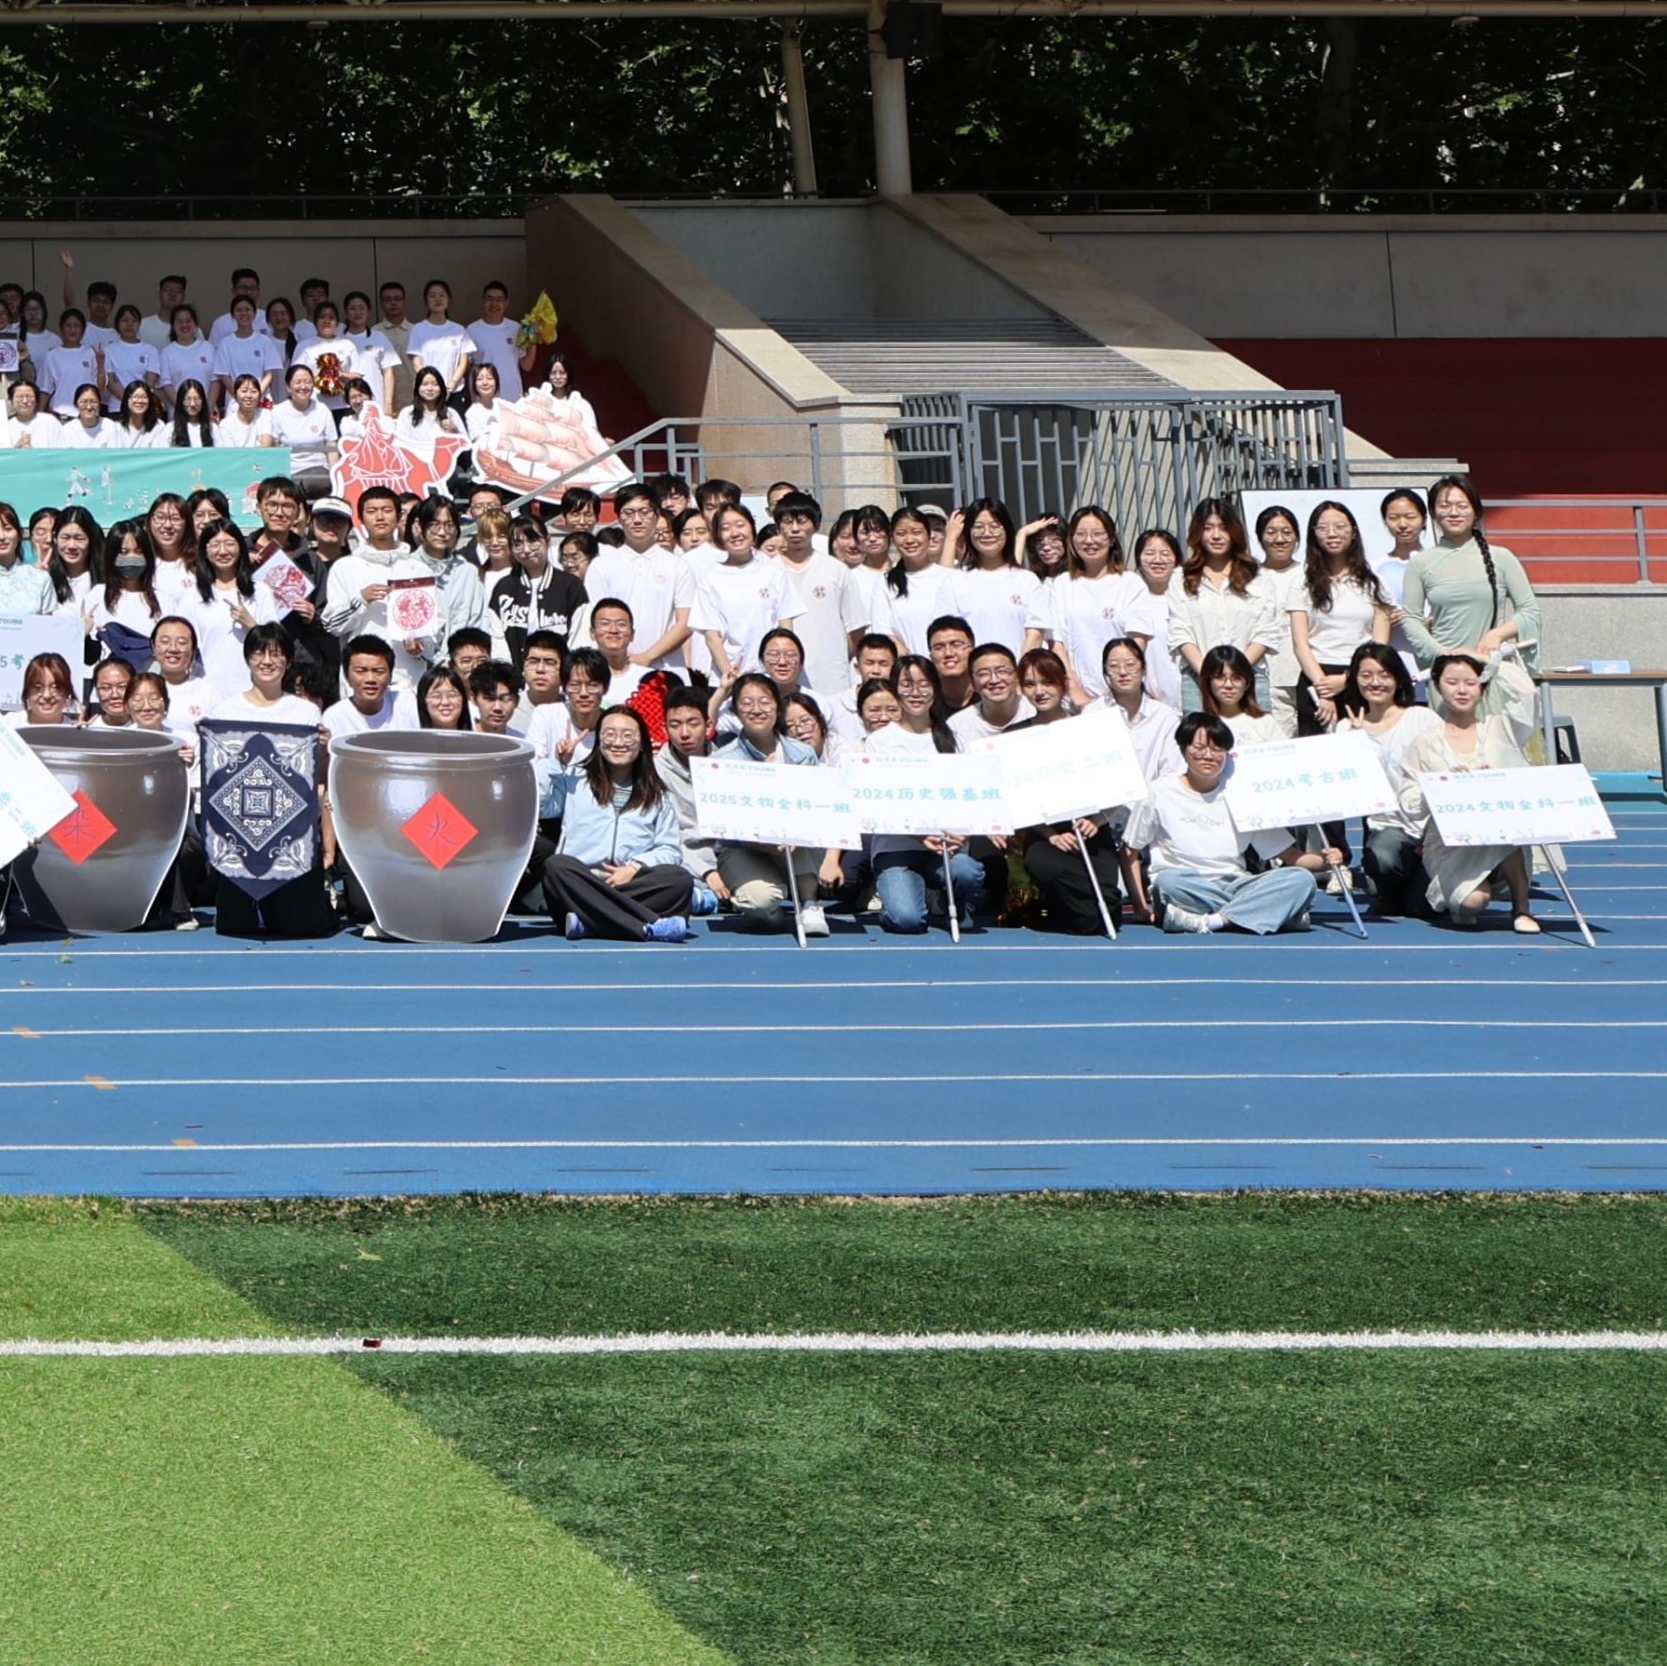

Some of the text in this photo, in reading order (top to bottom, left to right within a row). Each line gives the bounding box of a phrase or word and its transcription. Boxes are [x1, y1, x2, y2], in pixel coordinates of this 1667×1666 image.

[1251, 767, 1360, 794] 2024考古班
[851, 786, 1003, 802] 2024历史强基班
